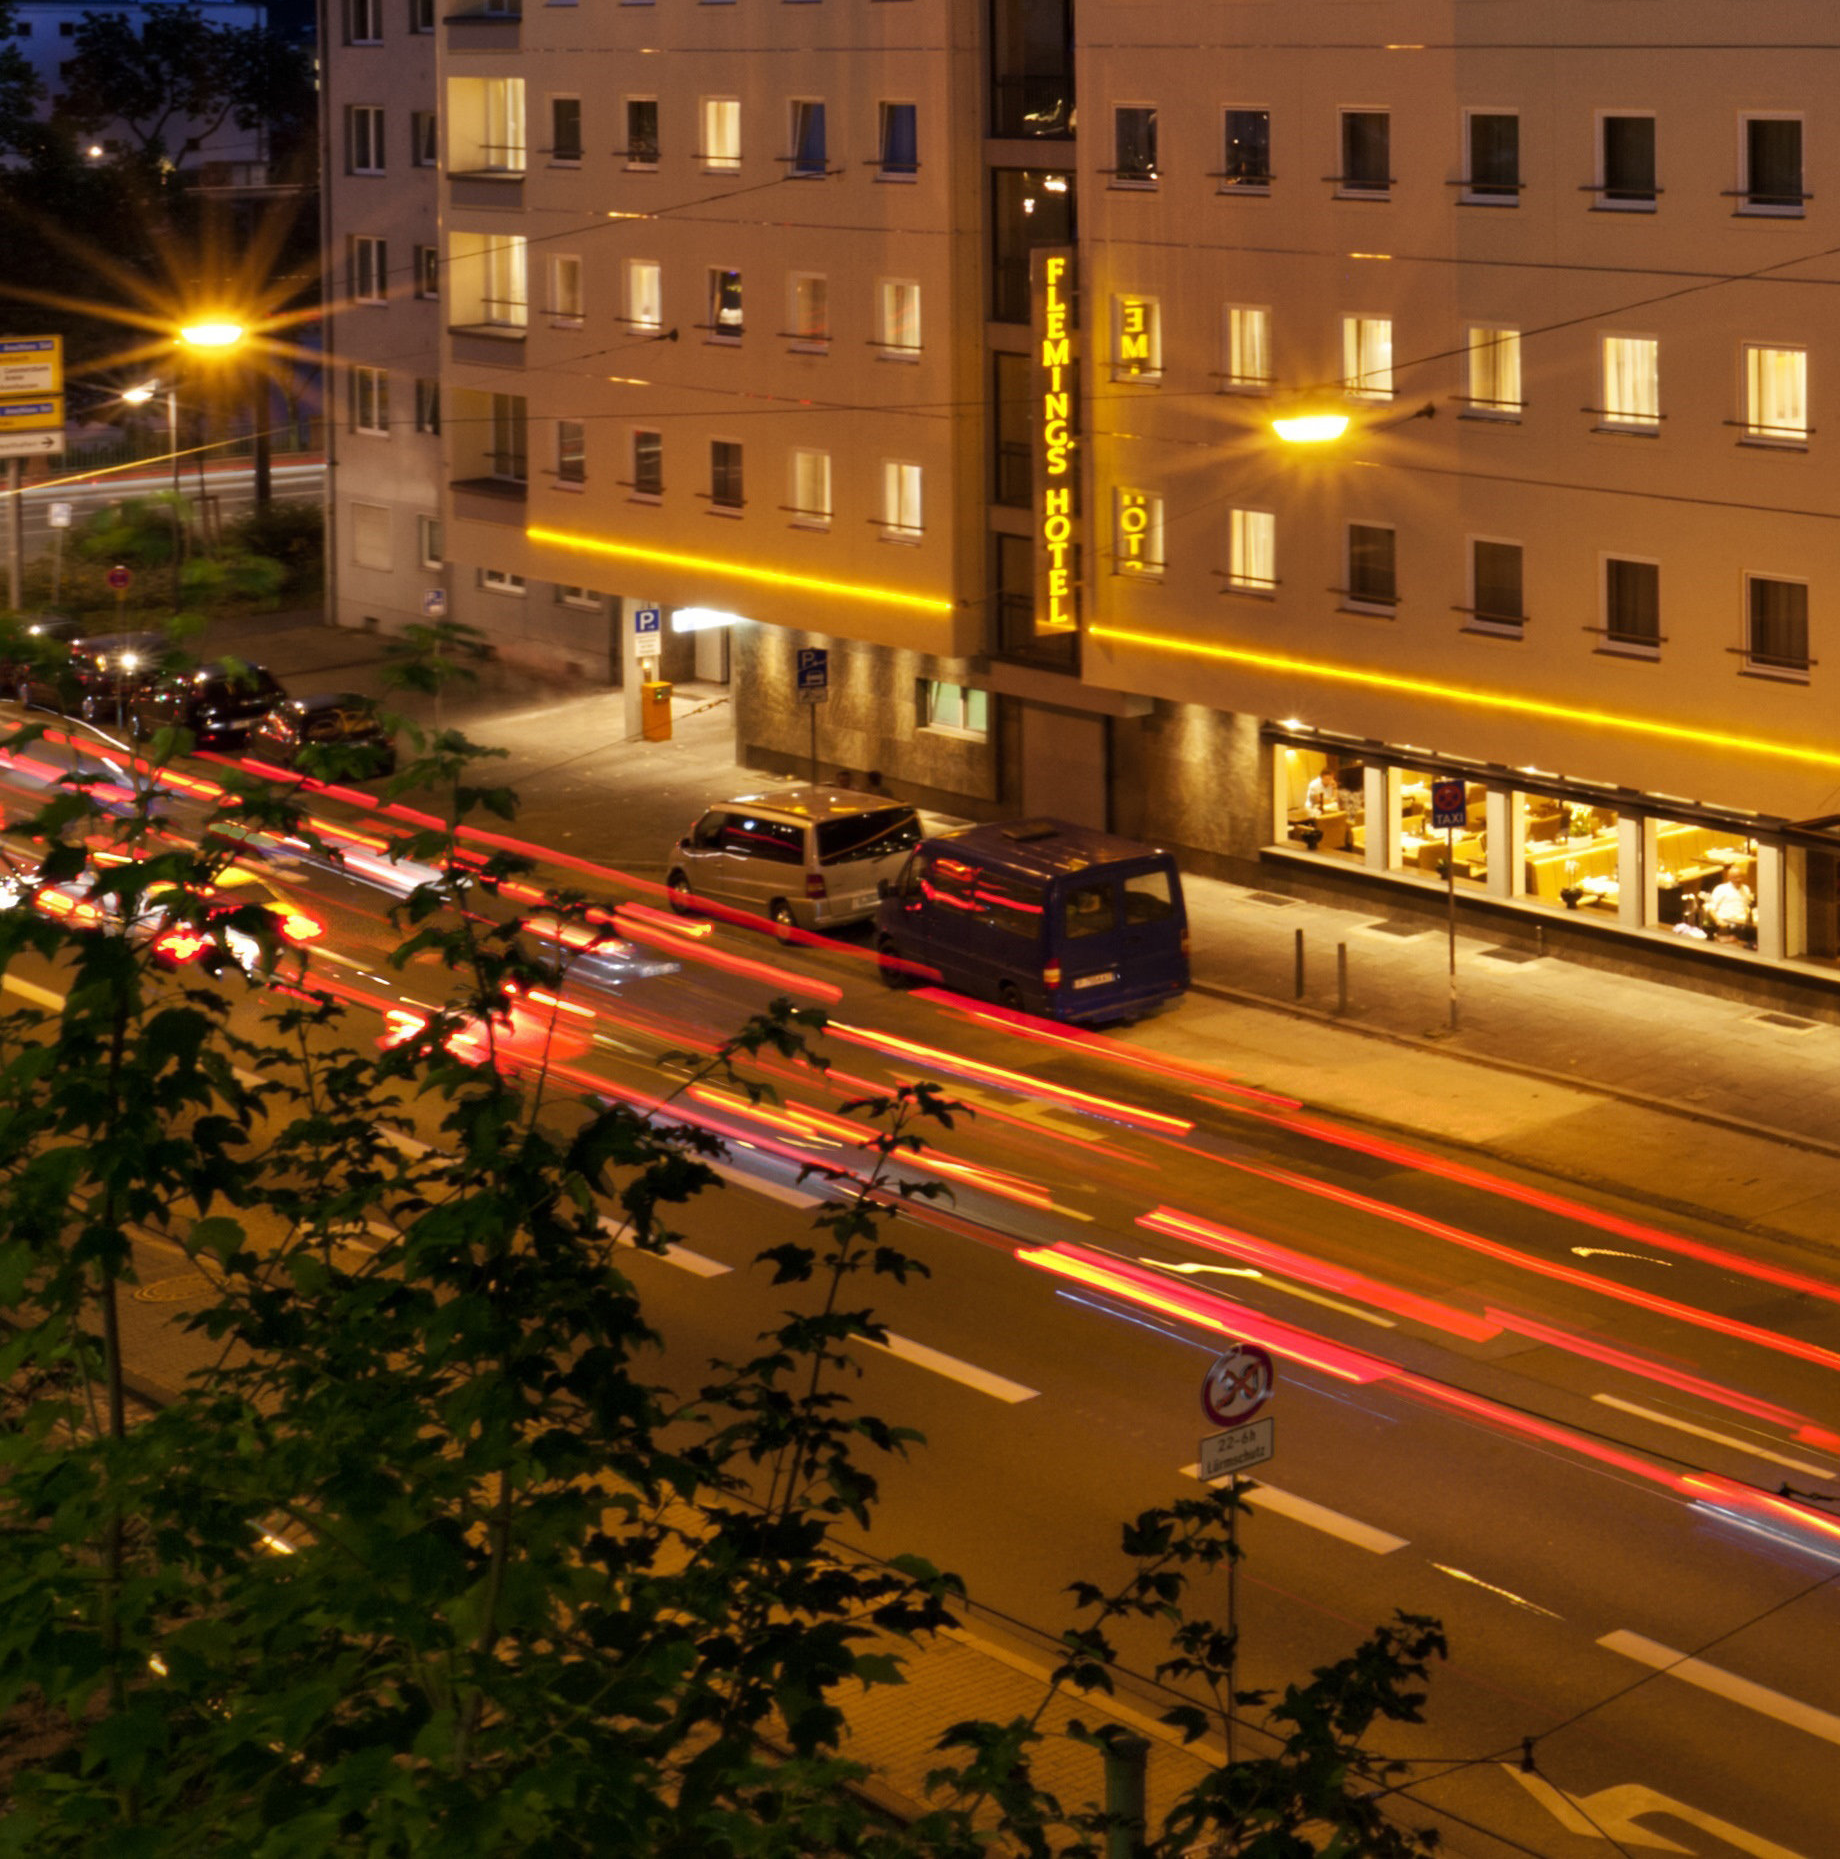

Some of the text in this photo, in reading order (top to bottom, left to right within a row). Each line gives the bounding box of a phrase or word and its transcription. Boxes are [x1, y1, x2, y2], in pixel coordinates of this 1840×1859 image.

[1043, 257, 1075, 624] FLEMING'S HOTEL
[639, 611, 655, 631] P
[1435, 813, 1464, 825] TAXI
[1206, 1446, 1266, 1475] Lärmschutz
